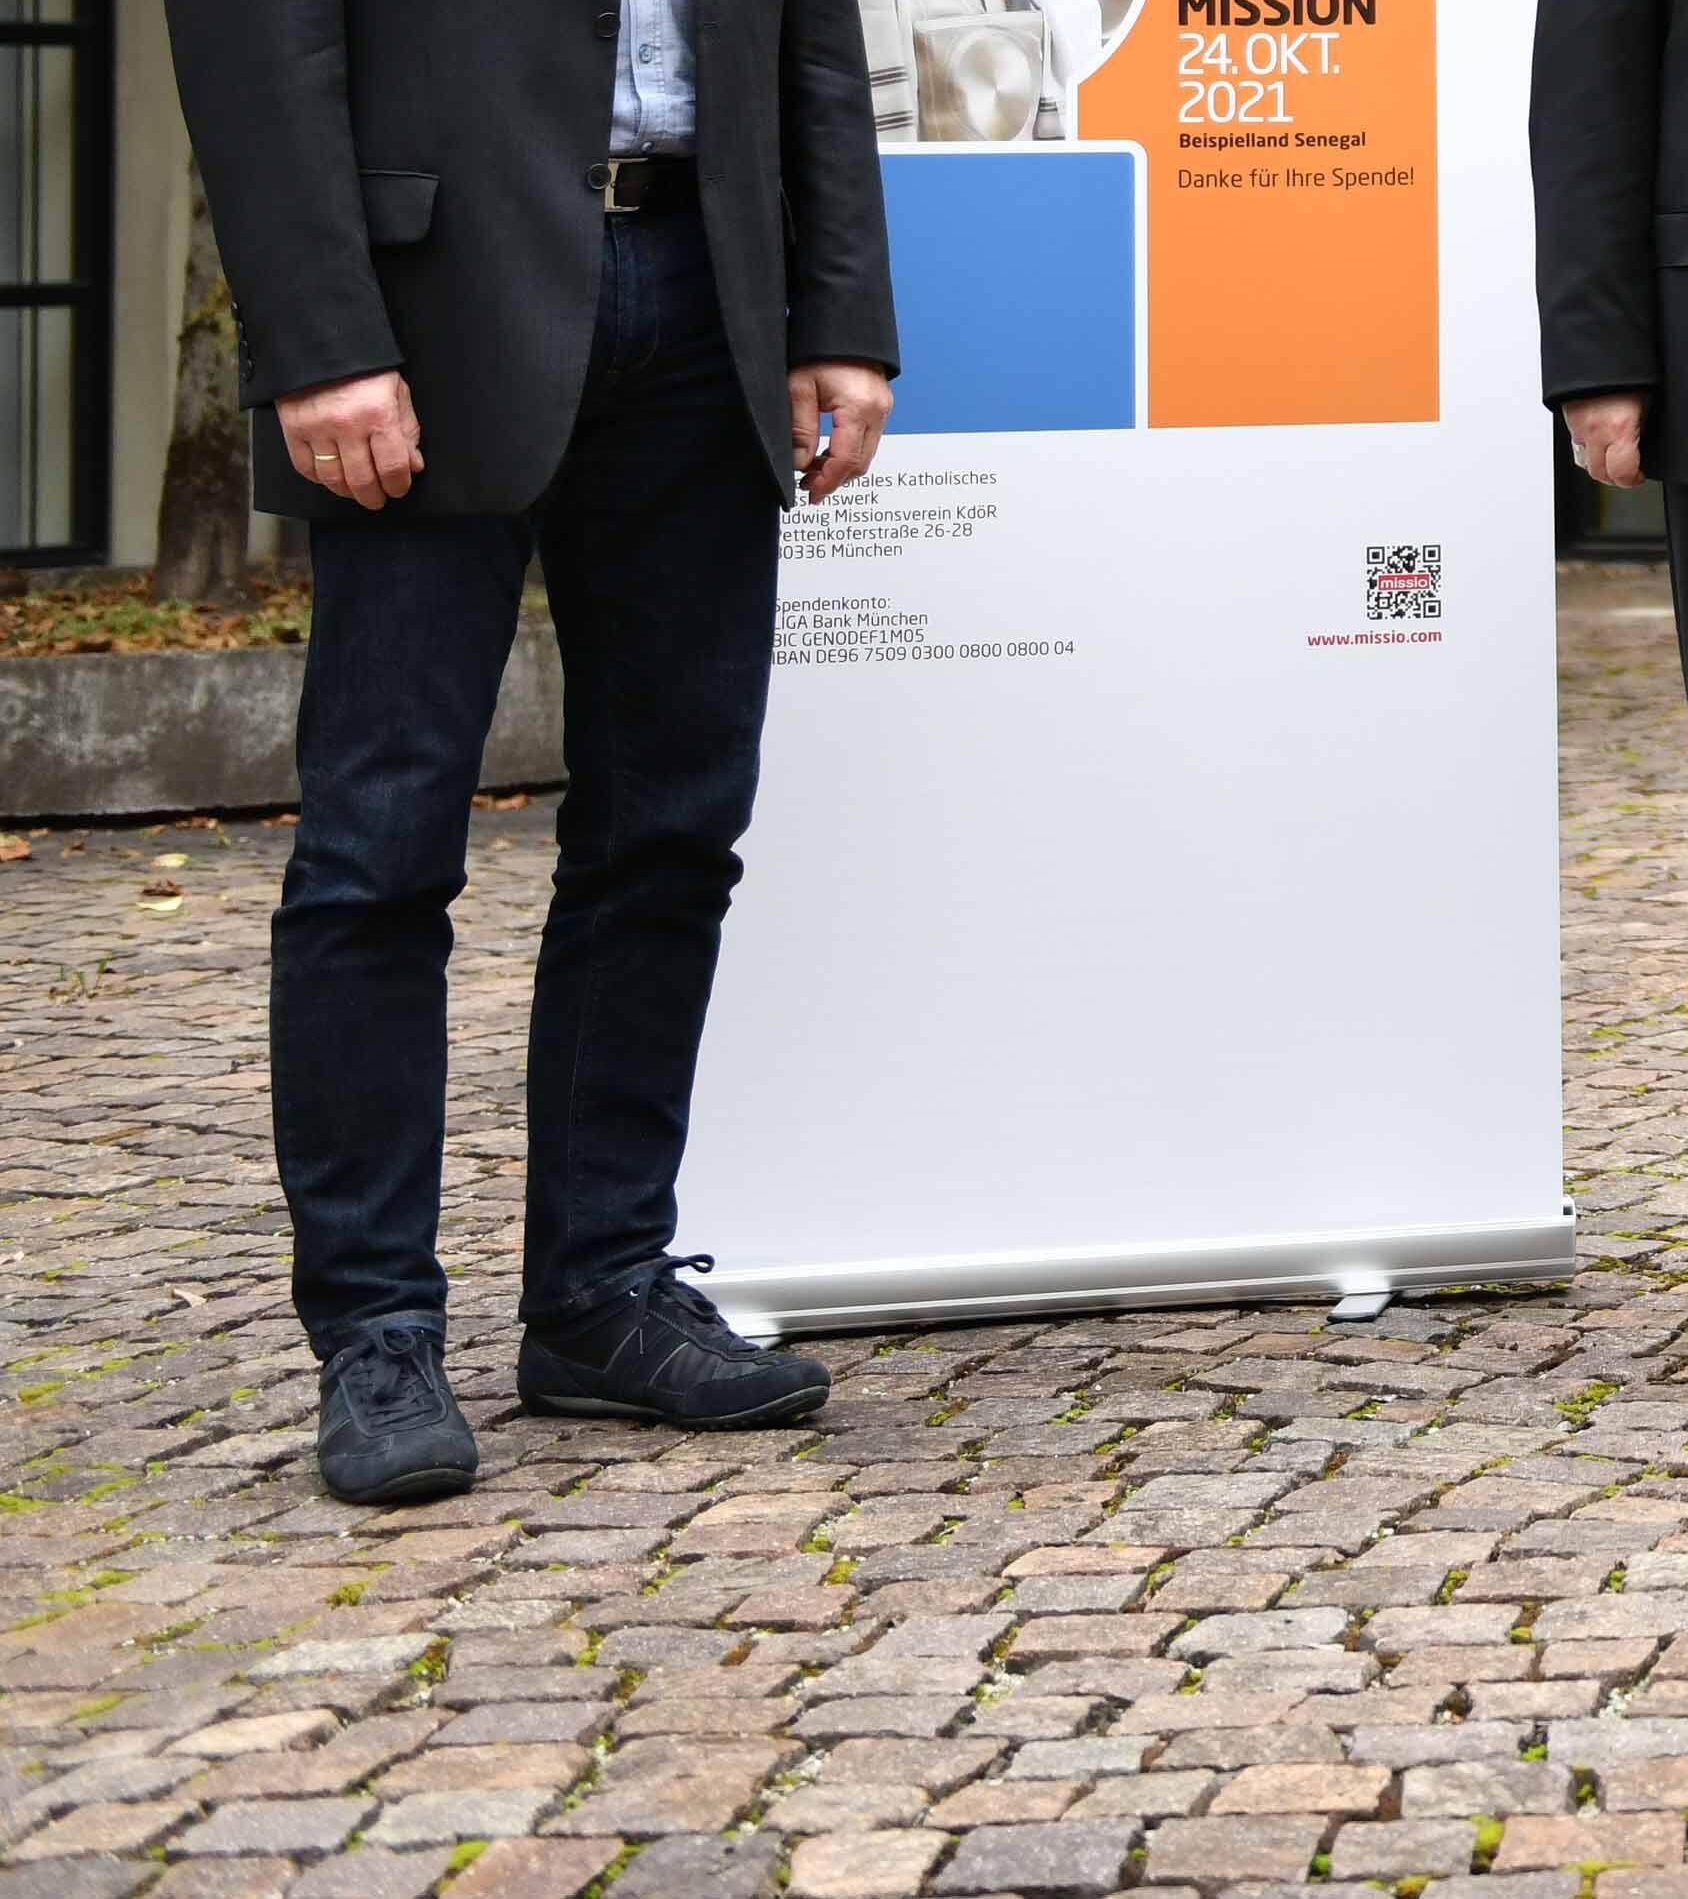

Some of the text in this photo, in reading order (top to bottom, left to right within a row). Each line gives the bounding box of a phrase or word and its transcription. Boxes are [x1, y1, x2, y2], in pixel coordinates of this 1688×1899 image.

[1178, 80, 1294, 123] 2021
[1179, 131, 1367, 152] Beispielland Senegal
[1178, 167, 1415, 190] Danke für Ihre Spende!
[897, 471, 998, 486] Katholisches
[781, 510, 830, 527] udwig
[835, 505, 952, 523] Missionsverein
[780, 523, 973, 543] ettenkoferstraße 26-28
[832, 542, 903, 558] München
[1380, 576, 1428, 589] missio
[813, 613, 852, 629] Bank
[857, 612, 928, 628] München
[1307, 630, 1442, 646] www.missio.com
[815, 647, 859, 664] DE96
[864, 644, 907, 661] 7509
[911, 643, 954, 660] 0300
[959, 642, 1001, 659] 0800
[1006, 640, 1049, 657] 0800
[1054, 640, 1075, 656] 04
